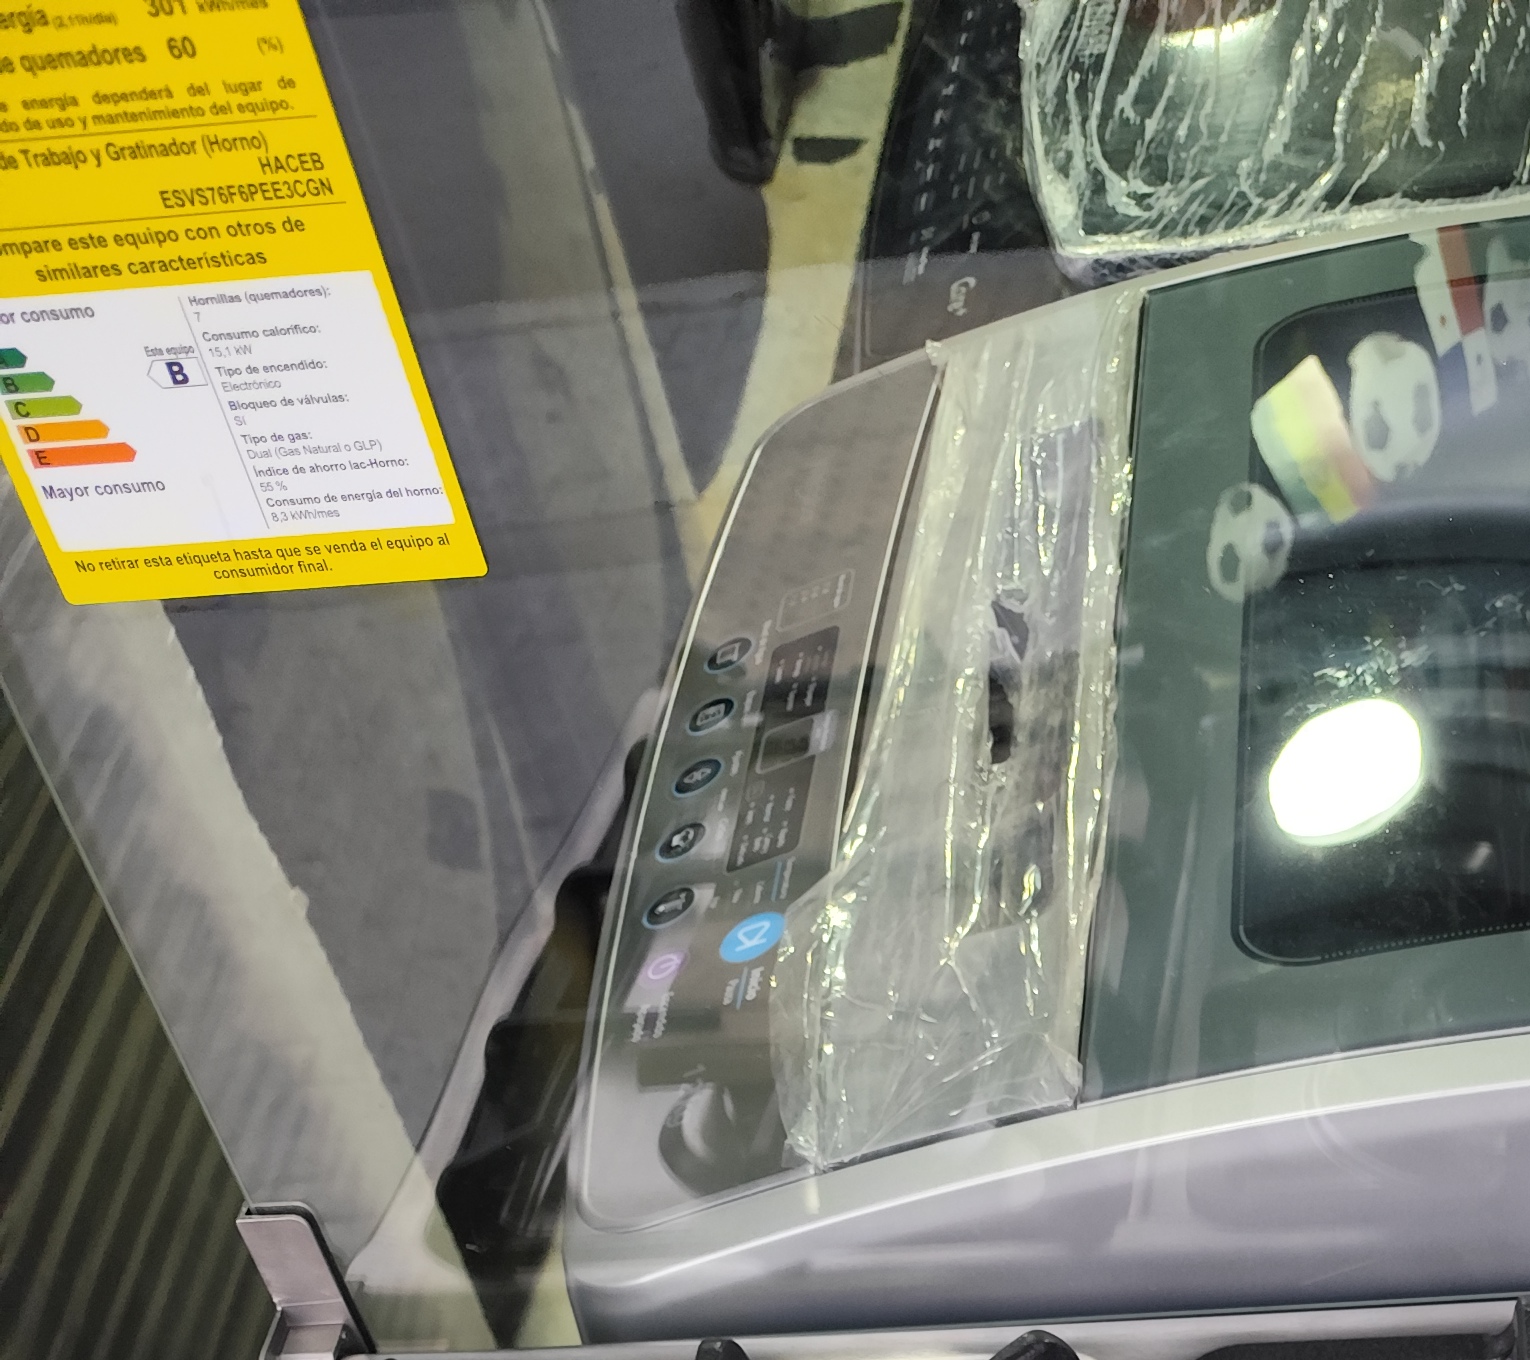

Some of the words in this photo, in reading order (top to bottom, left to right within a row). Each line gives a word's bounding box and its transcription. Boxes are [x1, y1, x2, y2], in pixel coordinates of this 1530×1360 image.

[20, 44, 147, 78] quemadores
[166, 36, 197, 59] 60
[256, 36, 285, 56] (%)
[186, 82, 211, 98] del
[222, 80, 263, 97] lugar
[277, 75, 296, 91] de
[22, 117, 43, 131] de
[45, 116, 75, 130] uso
[80, 116, 88, 131] y
[91, 99, 206, 126] mantenimiento
[209, 100, 232, 116] del
[236, 98, 294, 116] equipo.
[19, 145, 86, 170] Trabajo
[93, 150, 102, 168] y
[105, 138, 197, 162] Gratinador
[201, 131, 268, 158] (Horno)
[258, 152, 325, 175] HACEB
[159, 177, 334, 209] ESVS76F6PEE3CGN
[68, 232, 108, 250] este
[113, 227, 179, 250] equipo
[185, 224, 220, 241] con
[226, 220, 276, 237] otros
[282, 215, 305, 233] de
[36, 258, 122, 283] similares
[127, 250, 267, 275] características
[245, 286, 331, 306] (quemadores):
[20, 305, 95, 323] consumo
[193, 311, 201, 323] 7
[202, 328, 259, 343] Consumo
[262, 323, 321, 338] calorífico:
[166, 344, 195, 358] equipo
[208, 347, 232, 360] 15,1
[233, 344, 252, 356] kW
[165, 361, 190, 386] B
[215, 365, 242, 379] Tipo
[246, 364, 260, 376] de
[262, 358, 328, 374] encendido:
[3, 377, 19, 394] B
[222, 378, 282, 393] Electrónico
[14, 401, 30, 418] C
[228, 397, 277, 413] Bloqueo
[280, 396, 295, 407] de
[297, 393, 350, 406] válvulas:
[24, 426, 40, 442] D
[240, 433, 268, 446] Tipo
[270, 431, 285, 443] de
[287, 430, 313, 443] gas:
[35, 450, 51, 466] E
[247, 448, 273, 460] Dual
[274, 445, 302, 460] (Gas
[302, 443, 342, 456] Natural
[344, 444, 352, 452] o
[354, 438, 382, 452] GLP)
[292, 462, 307, 474] de
[309, 460, 347, 474] ahorro
[41, 483, 89, 502] Mayor
[94, 480, 165, 496] consumo
[259, 482, 274, 493] 55
[275, 480, 288, 491] %
[266, 495, 321, 508] Consumo
[323, 492, 339, 504] de
[340, 489, 384, 505] energía
[385, 486, 404, 499] del
[405, 484, 444, 498] horno:
[270, 511, 290, 524] 8,3
[290, 507, 341, 521] kWh/mes
[75, 559, 96, 573] No
[98, 555, 140, 572] retirar
[143, 552, 172, 568] esta
[176, 547, 231, 567] etiqueta
[233, 545, 273, 561] hasta
[276, 545, 302, 560] que
[304, 544, 321, 556] se
[324, 537, 367, 554] venda
[370, 536, 382, 550] el
[386, 534, 434, 554] equipo
[437, 533, 450, 547] al
[213, 559, 294, 580] consumidor
[298, 558, 333, 573] final.
